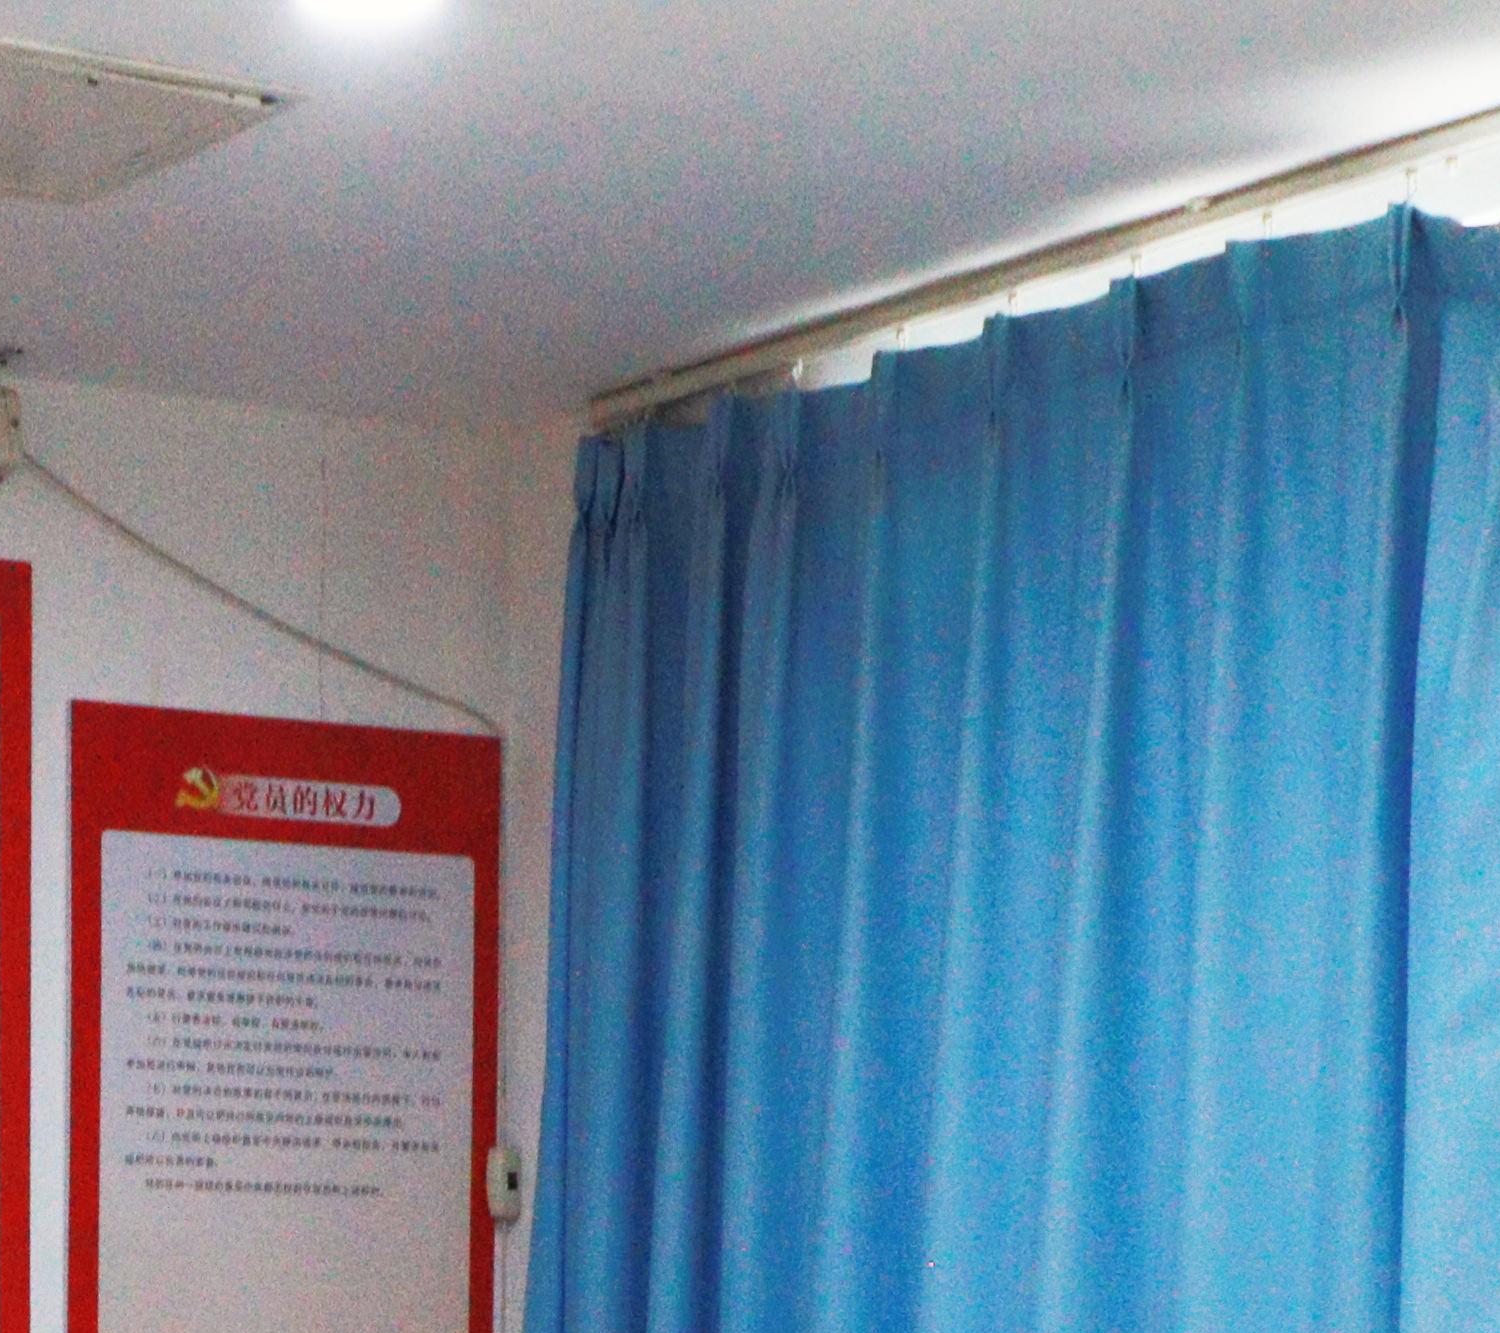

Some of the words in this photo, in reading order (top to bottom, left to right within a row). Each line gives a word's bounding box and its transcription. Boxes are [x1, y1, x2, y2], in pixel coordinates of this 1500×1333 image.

[233, 781, 376, 820] 党员的权力
